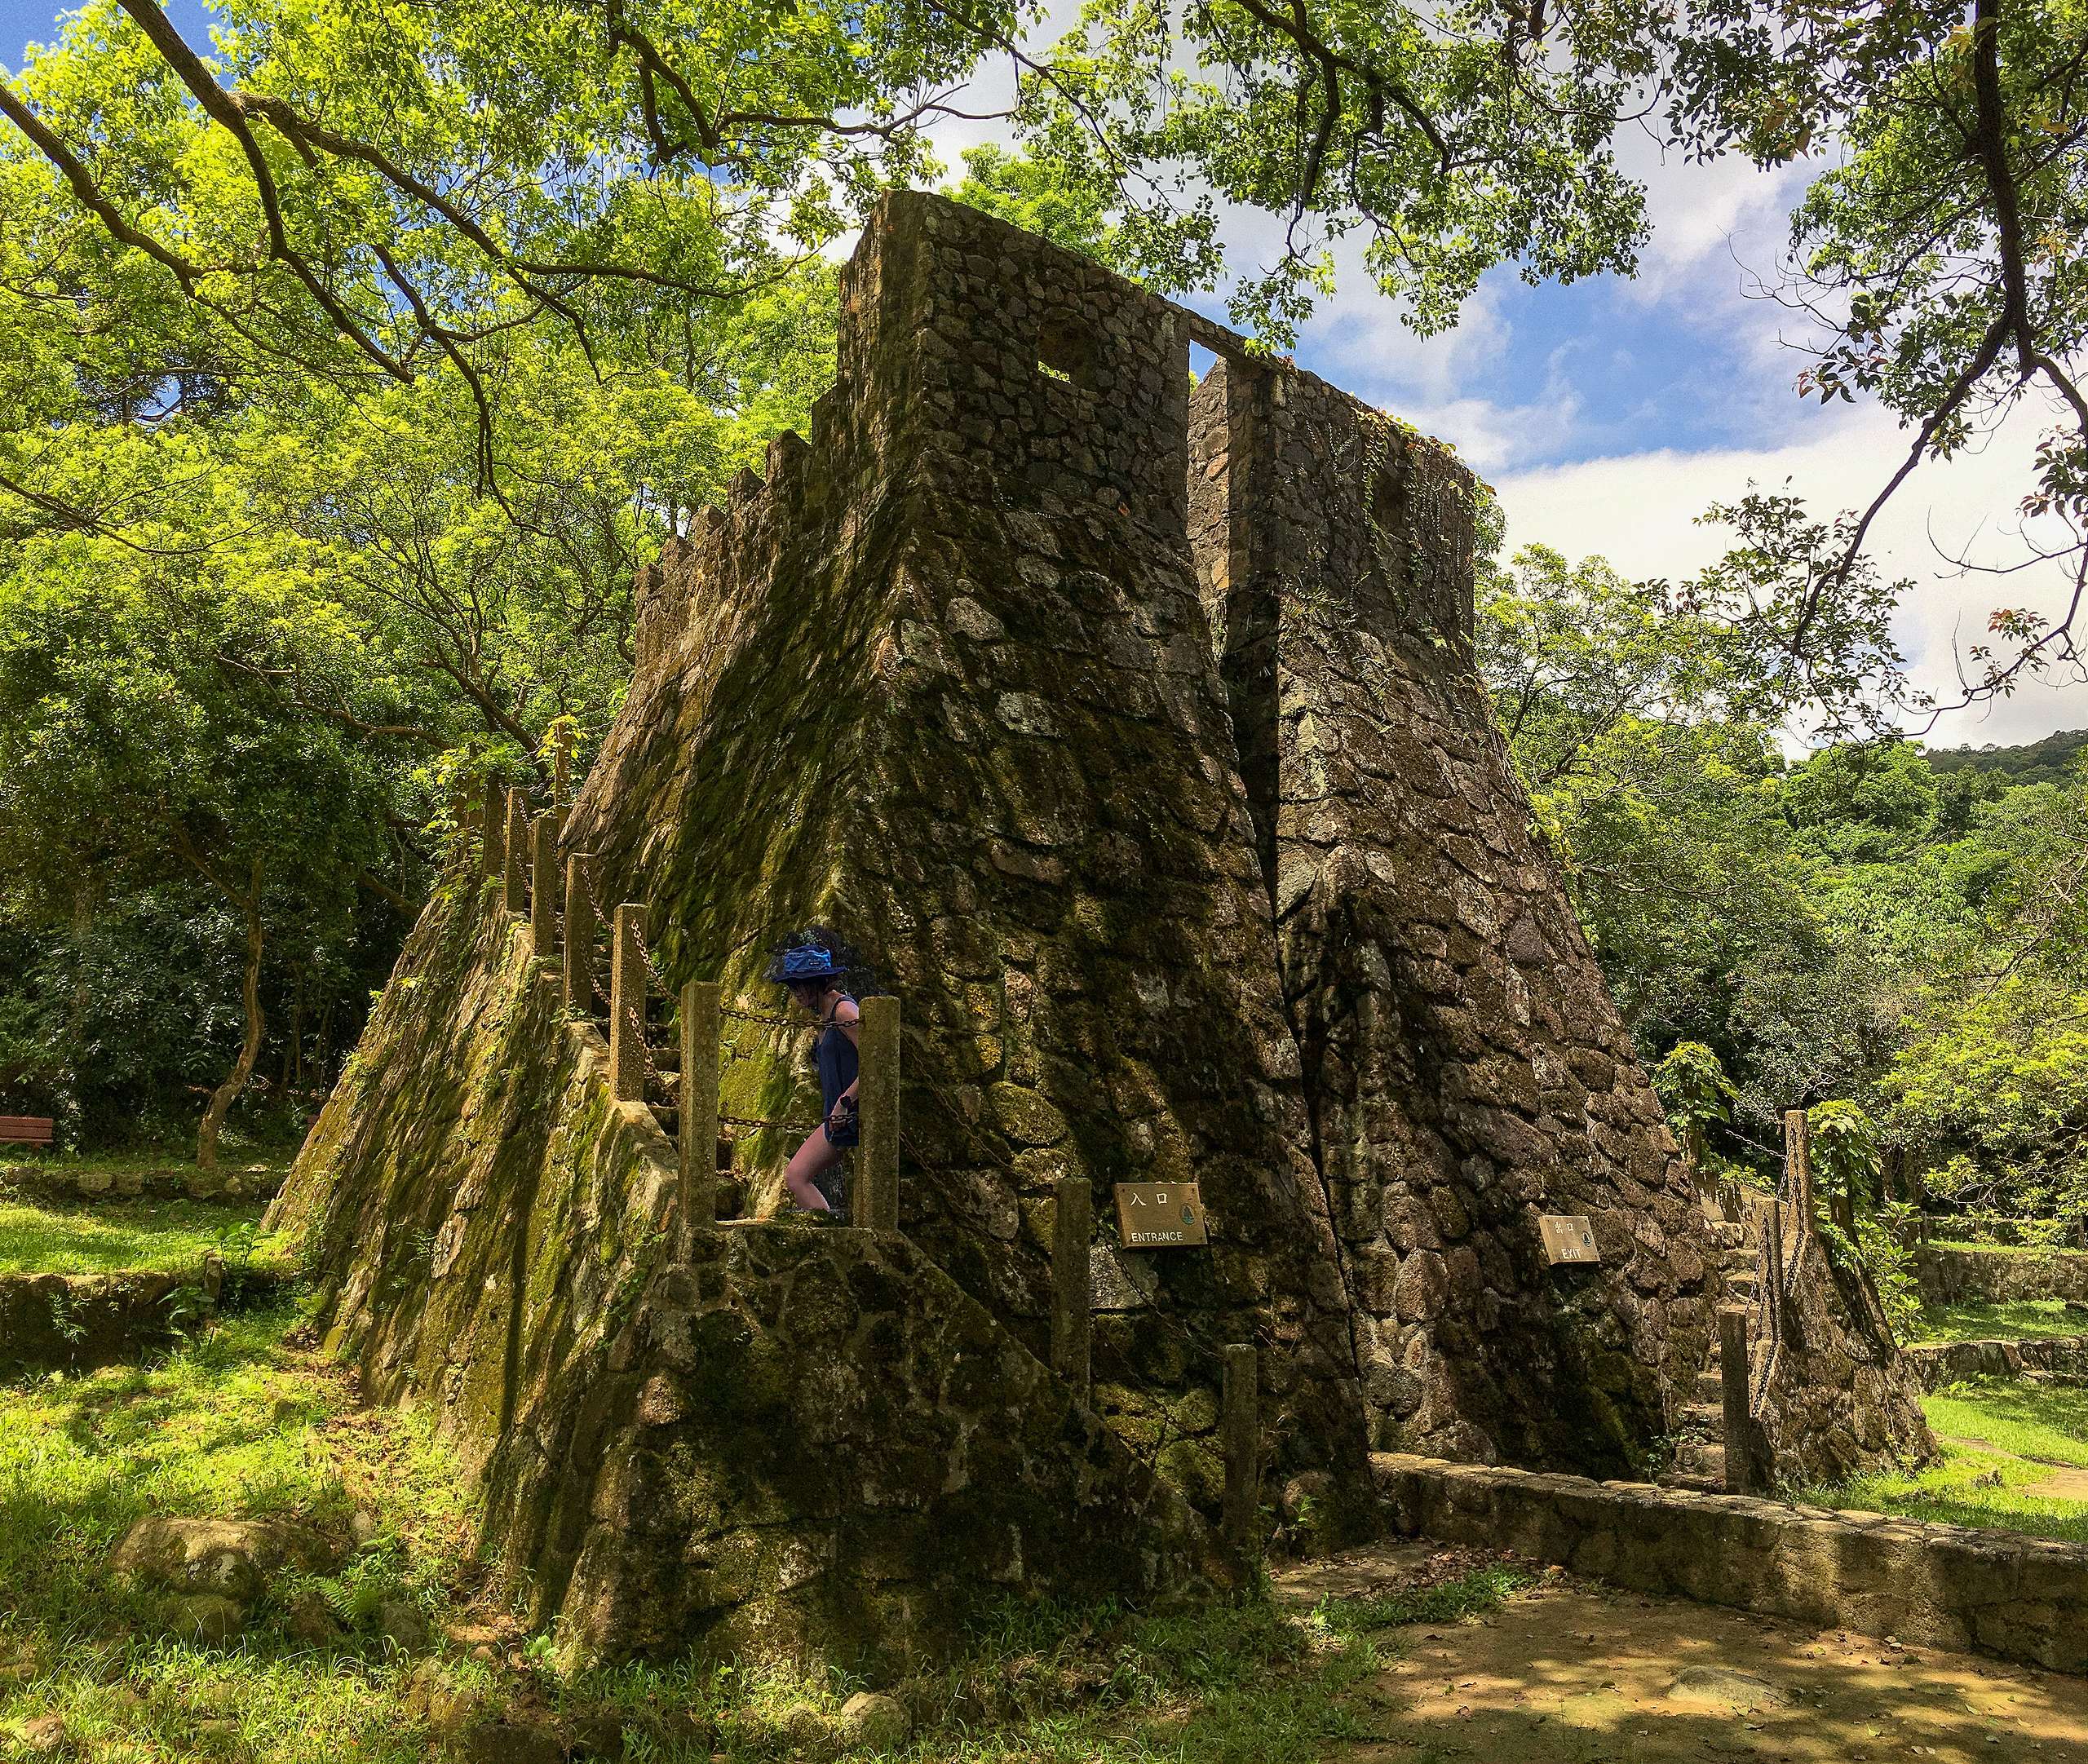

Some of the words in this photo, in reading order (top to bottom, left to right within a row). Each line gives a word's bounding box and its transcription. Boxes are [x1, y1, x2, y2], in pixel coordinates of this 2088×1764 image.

[1130, 1192, 1168, 1206] 入口
[1555, 1221, 1574, 1235] 出口
[1130, 1231, 1184, 1242] ENTRANCE
[1561, 1248, 1581, 1259] EXIT
